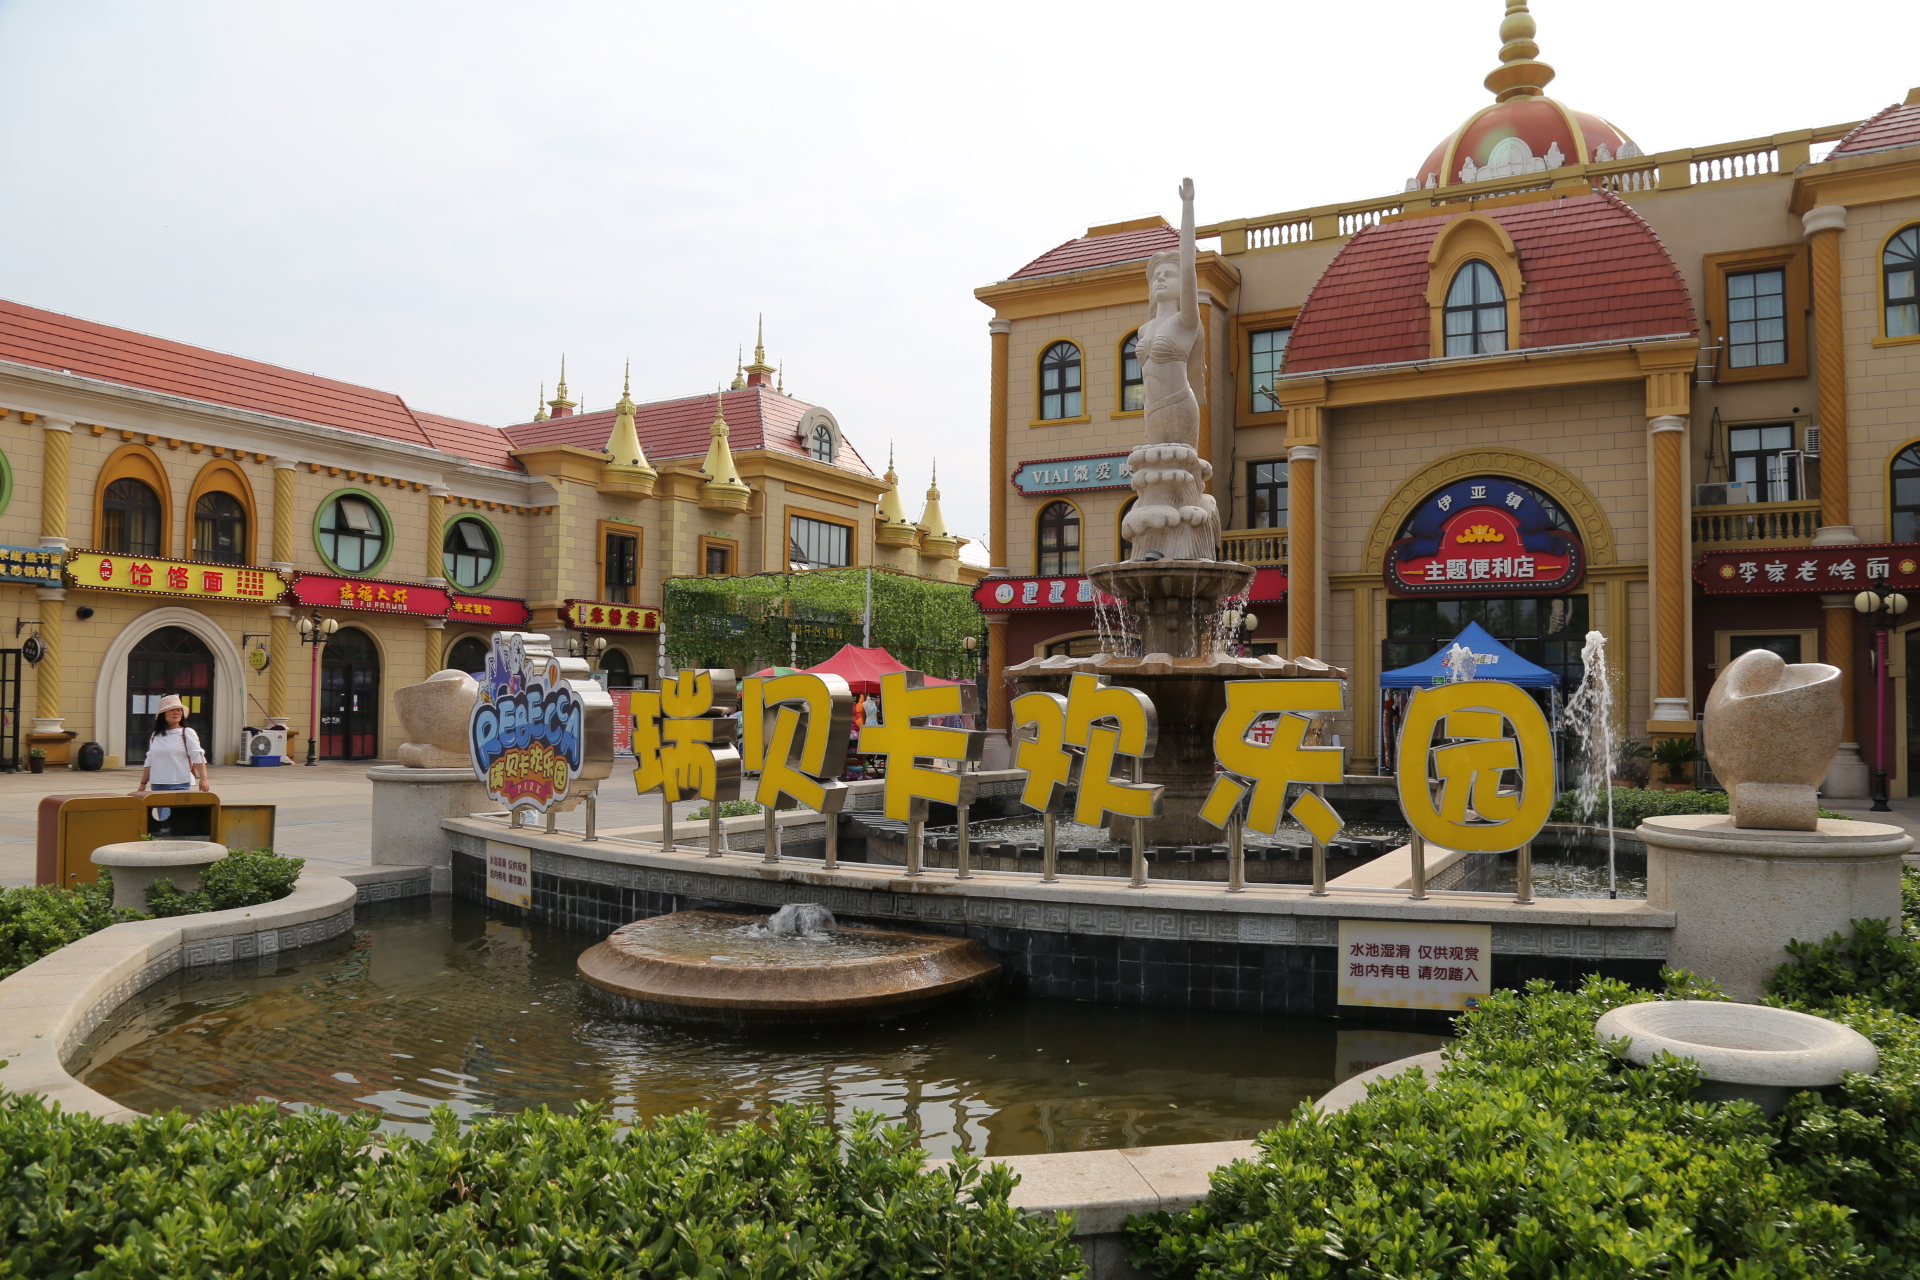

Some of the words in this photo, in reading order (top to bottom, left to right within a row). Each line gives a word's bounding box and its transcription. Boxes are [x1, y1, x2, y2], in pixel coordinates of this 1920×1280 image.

[1032, 468, 1069, 484] VIAI
[1437, 485, 1524, 512] 伊亚镇
[129, 561, 223, 592] 饸饹面
[1425, 555, 1534, 581] 主题便利店
[1738, 556, 1890, 584] 李家老烩面
[475, 690, 580, 770] REBECCA
[489, 745, 568, 791] 瑞贝卡欢乐园
[629, 668, 1555, 854] 瑞贝卡欢乐园
[516, 781, 542, 795] PARK
[1349, 942, 1411, 959] 水池湿滑
[1417, 944, 1479, 962] 仅供观赏
[1349, 962, 1411, 979] 池内有电
[1417, 965, 1479, 982] 请勿踏入
